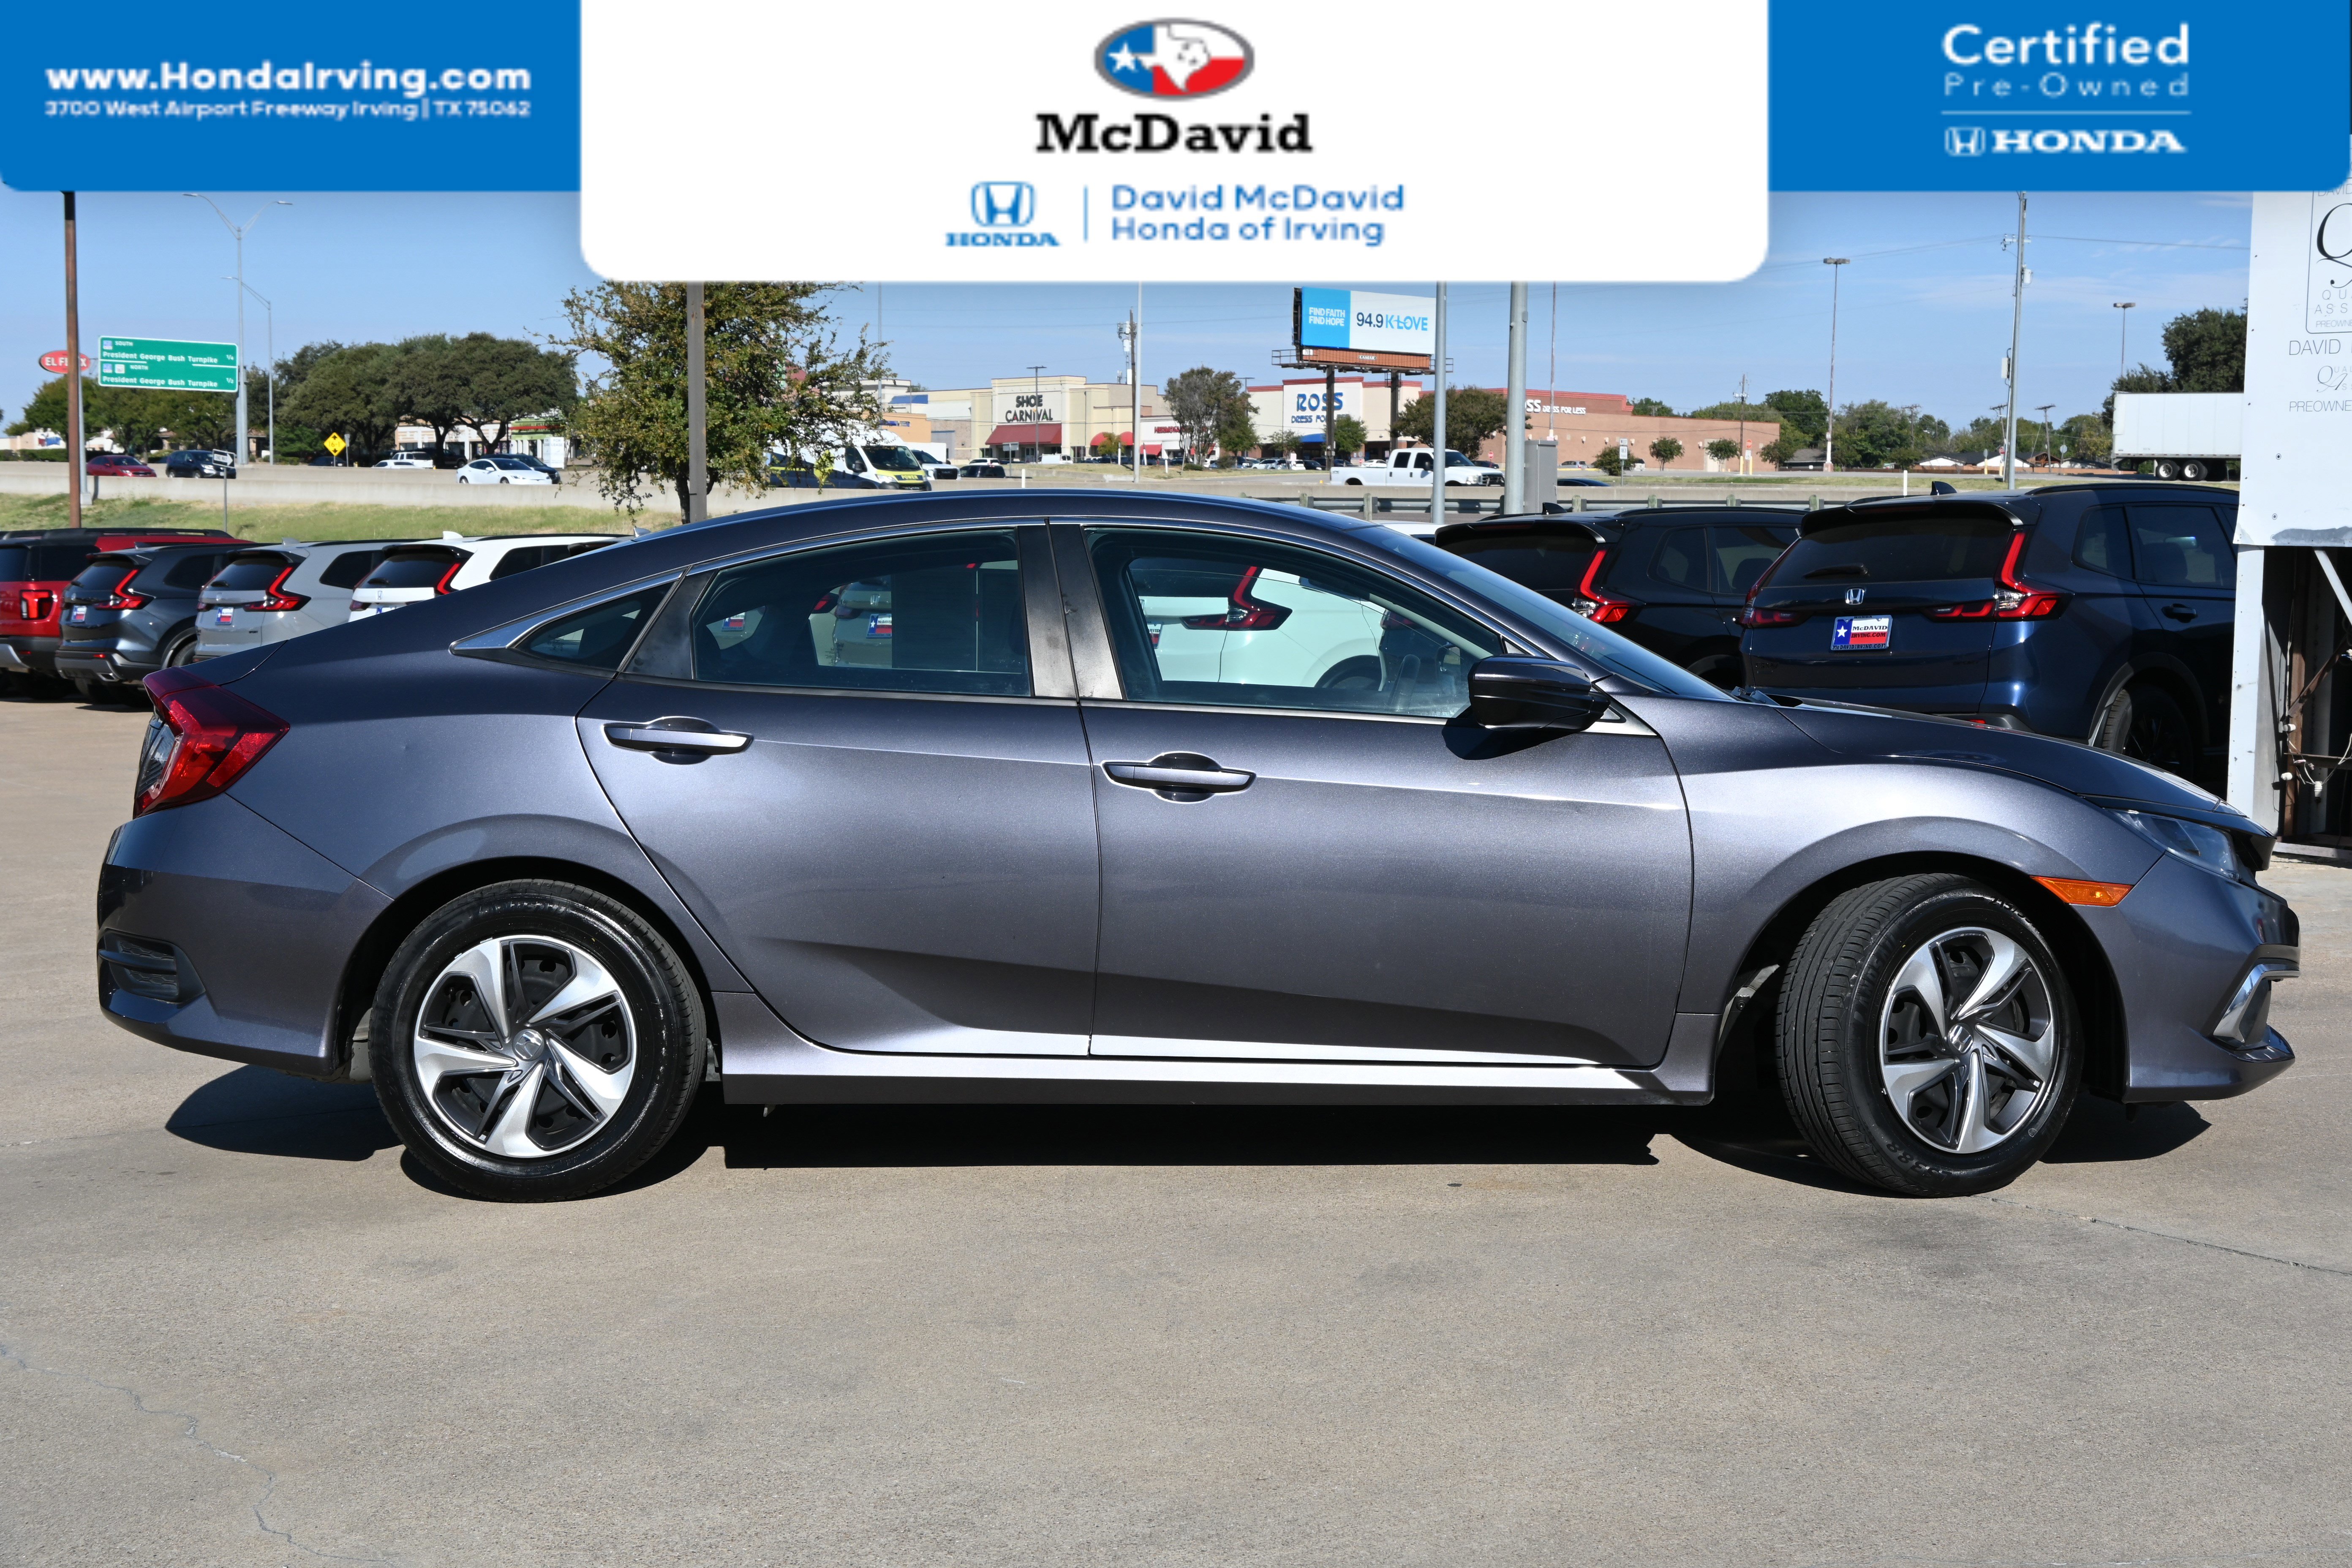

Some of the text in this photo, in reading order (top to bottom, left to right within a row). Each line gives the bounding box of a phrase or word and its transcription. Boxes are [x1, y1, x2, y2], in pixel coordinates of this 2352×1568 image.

[1309, 307, 1345, 318] FIND FAITH
[1309, 316, 1345, 326] FIND HOPE
[1356, 312, 1384, 328] 94.9
[2289, 339, 2341, 355] DAVID
[45, 357, 57, 366] EL
[140, 353, 165, 362] George
[188, 356, 218, 364] Turnpike
[140, 377, 165, 386] George
[188, 380, 218, 388] Turnpike
[1015, 395, 1043, 408] SHOE
[1005, 408, 1053, 423] CARNIVAL
[1291, 415, 1313, 423] DRESS
